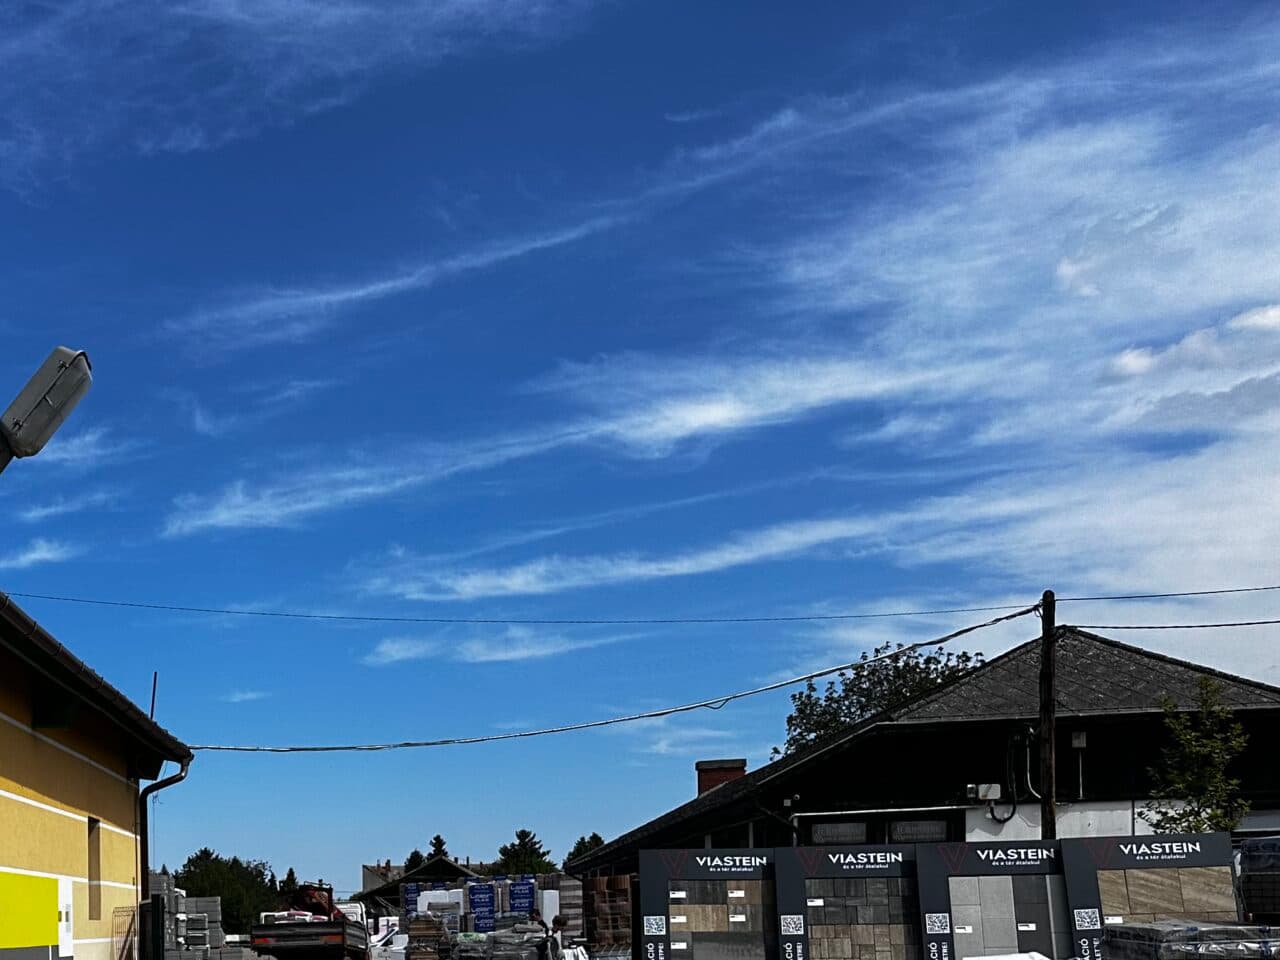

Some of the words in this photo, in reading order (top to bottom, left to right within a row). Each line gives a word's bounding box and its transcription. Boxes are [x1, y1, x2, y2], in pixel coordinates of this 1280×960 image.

[976, 848, 1055, 860] VIASTEIN
[1119, 842, 1201, 854] VIASTEIN
[695, 856, 767, 866] VIASTEIN
[828, 852, 903, 864] VIASTEIN
